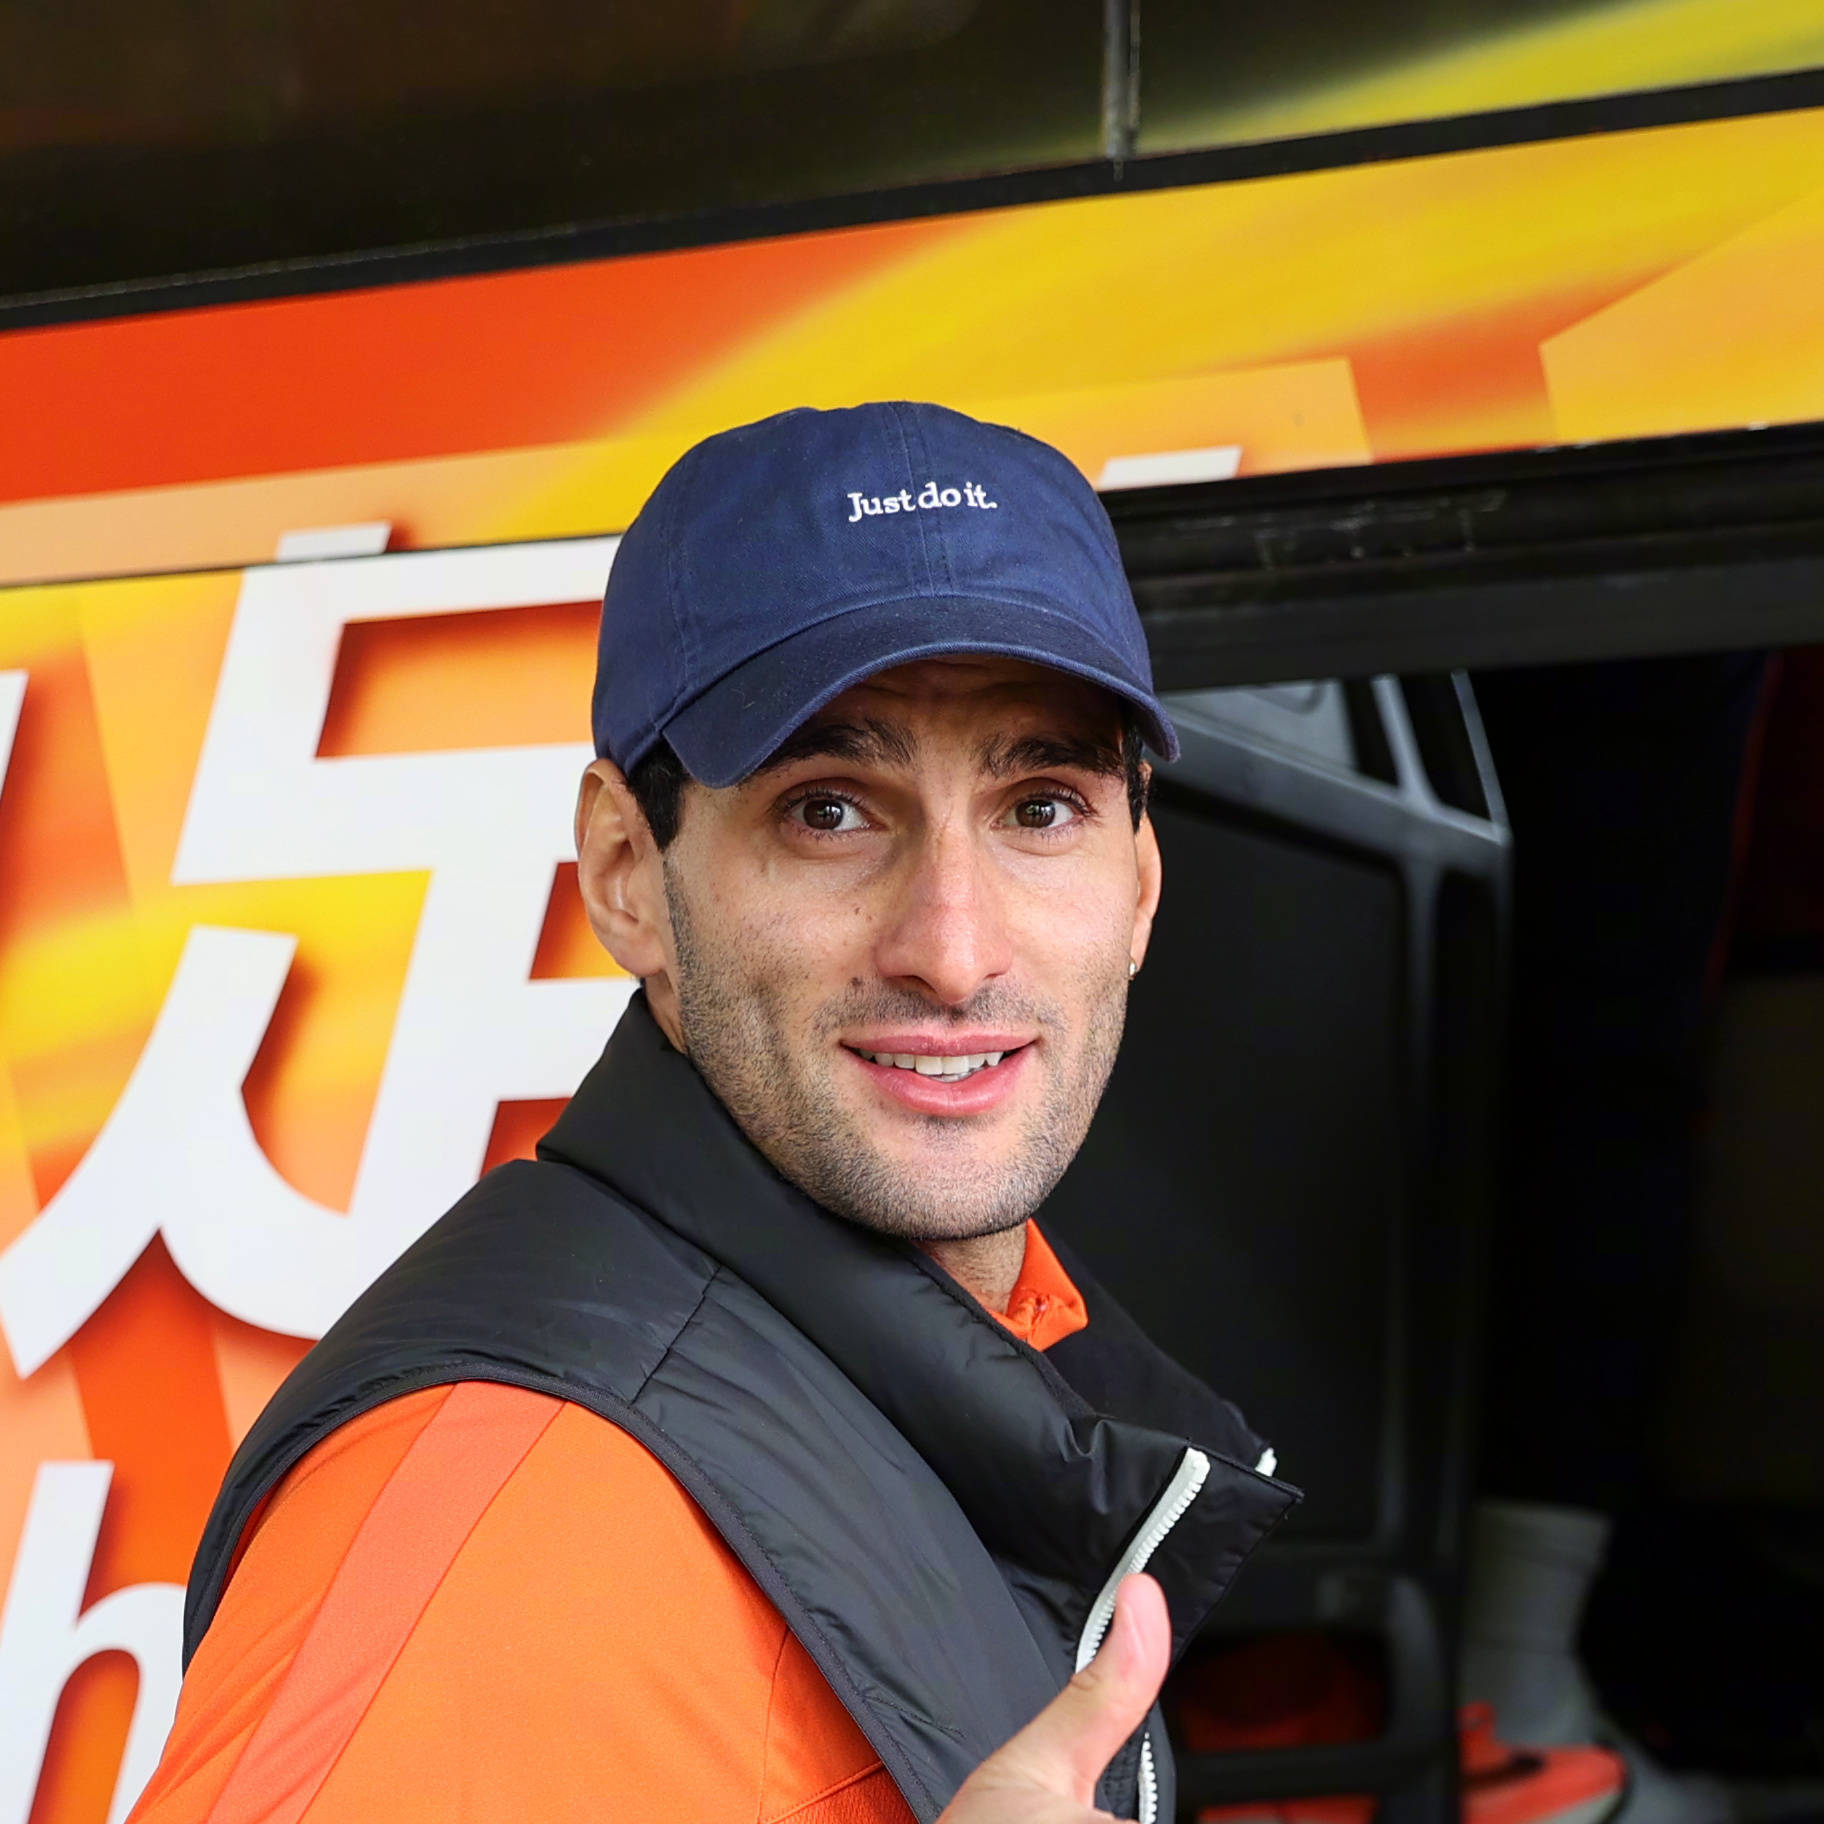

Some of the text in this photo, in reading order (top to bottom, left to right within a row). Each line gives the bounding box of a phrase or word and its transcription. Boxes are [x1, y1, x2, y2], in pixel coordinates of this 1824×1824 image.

[847, 481, 998, 523] Just do it.
